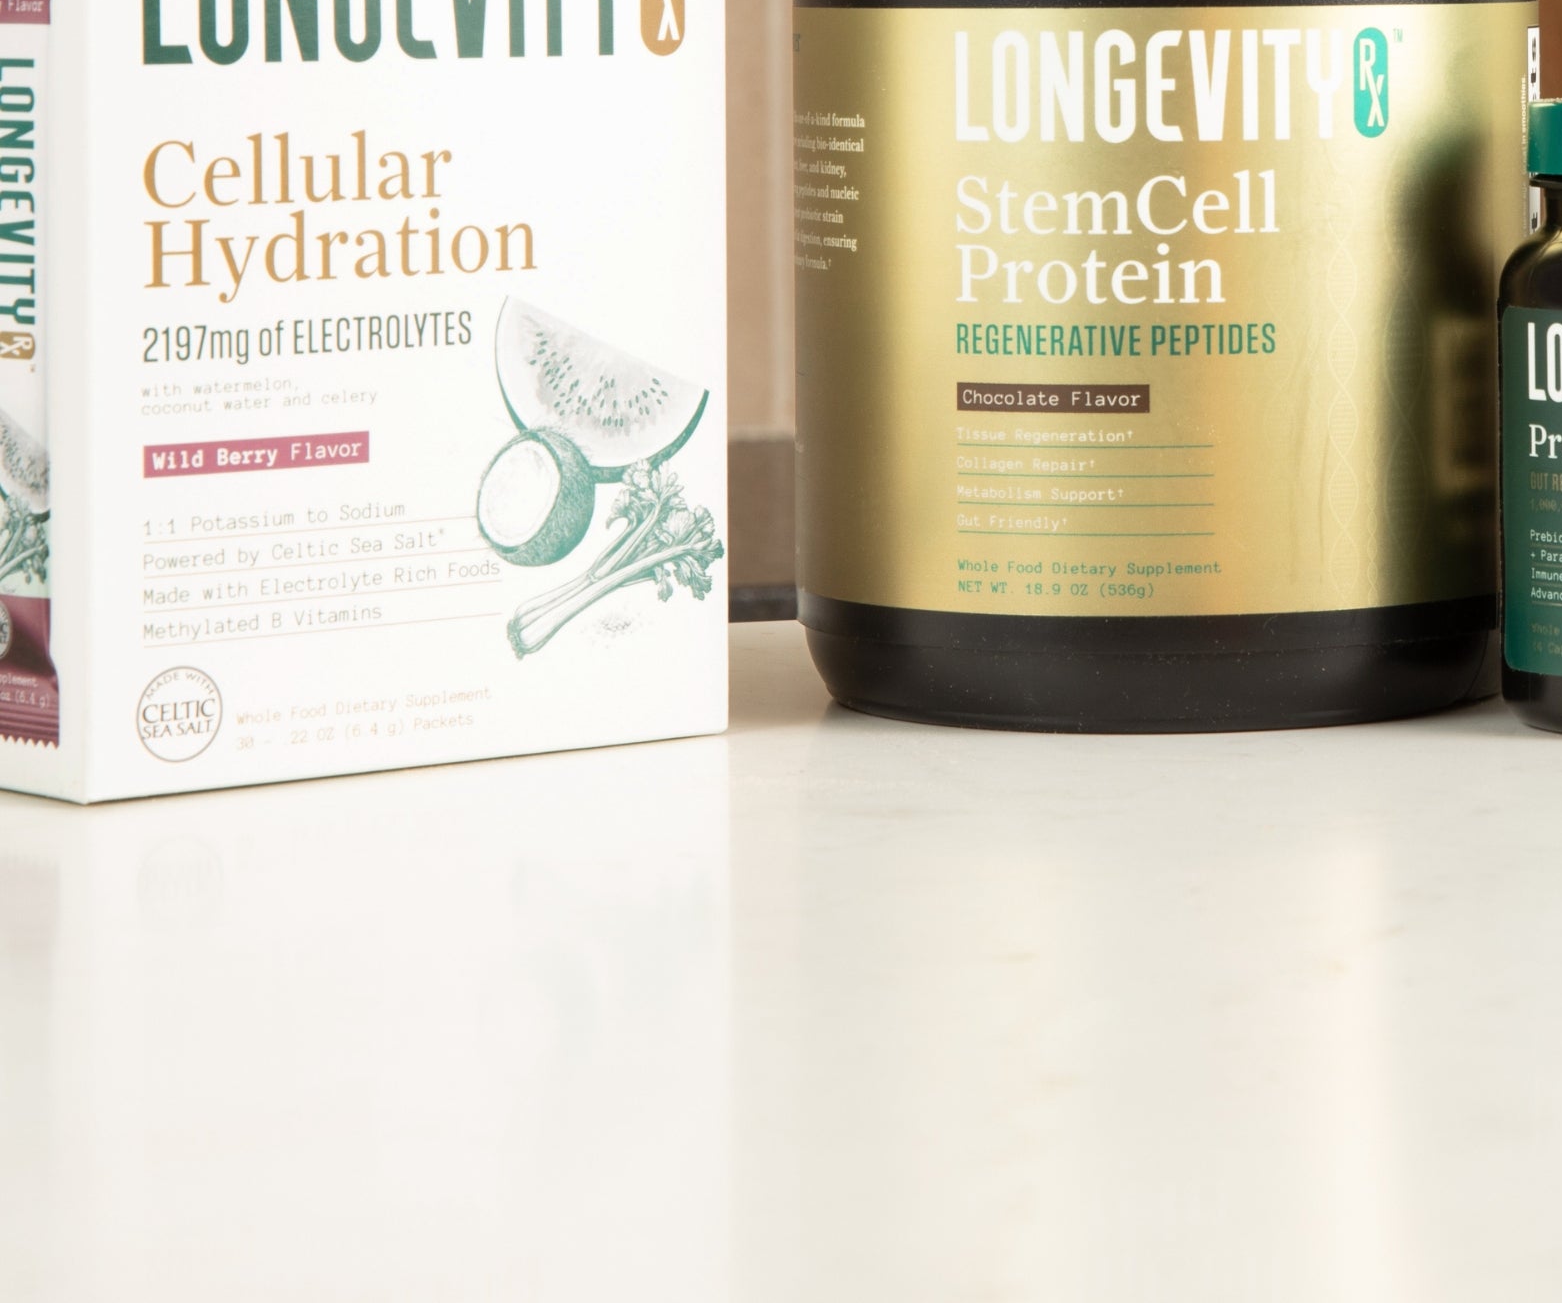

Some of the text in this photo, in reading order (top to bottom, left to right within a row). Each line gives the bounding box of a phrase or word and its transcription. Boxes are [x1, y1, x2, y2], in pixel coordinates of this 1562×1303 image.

[955, 29, 1344, 143] LONGEVITY
[143, 130, 453, 208] Cellular
[955, 169, 1280, 236] StemCell
[144, 207, 538, 303] Hydration
[956, 243, 1226, 305] Protein
[143, 311, 473, 365] 2197mg of ELECTROLYTES
[957, 323, 1276, 356] REGENERATIVE PEPTIDES
[141, 382, 182, 398] with
[141, 389, 377, 416] coconut water and celery
[962, 389, 1142, 408] Chocolate Flavor
[957, 426, 1006, 442] Tissue
[152, 441, 362, 472] Wild Berry Flavor
[957, 456, 1023, 472] Collagen
[957, 485, 1042, 500] Metabolism
[1531, 472, 1549, 490] GUT
[144, 502, 406, 537] 1:1 Potassium to Sodium
[957, 514, 981, 528] Gut
[144, 547, 225, 571] Powered
[237, 545, 260, 567] by
[271, 540, 339, 561] Celtic
[350, 536, 383, 554] Sea
[958, 559, 1222, 578] Whole Food Dietary Supplement
[144, 559, 501, 606] Made with Electrolyte Rich Foods
[958, 581, 983, 594] NET
[1025, 582, 1061, 596] 18.9
[1070, 583, 1089, 596] OZ
[1099, 583, 1156, 599] (536g)
[144, 605, 382, 642] Methylated B Vitamins
[142, 698, 216, 724] CELTIC
[236, 687, 493, 726] Whole Food Dietary Supplement
[143, 717, 213, 740] SEA SALT
